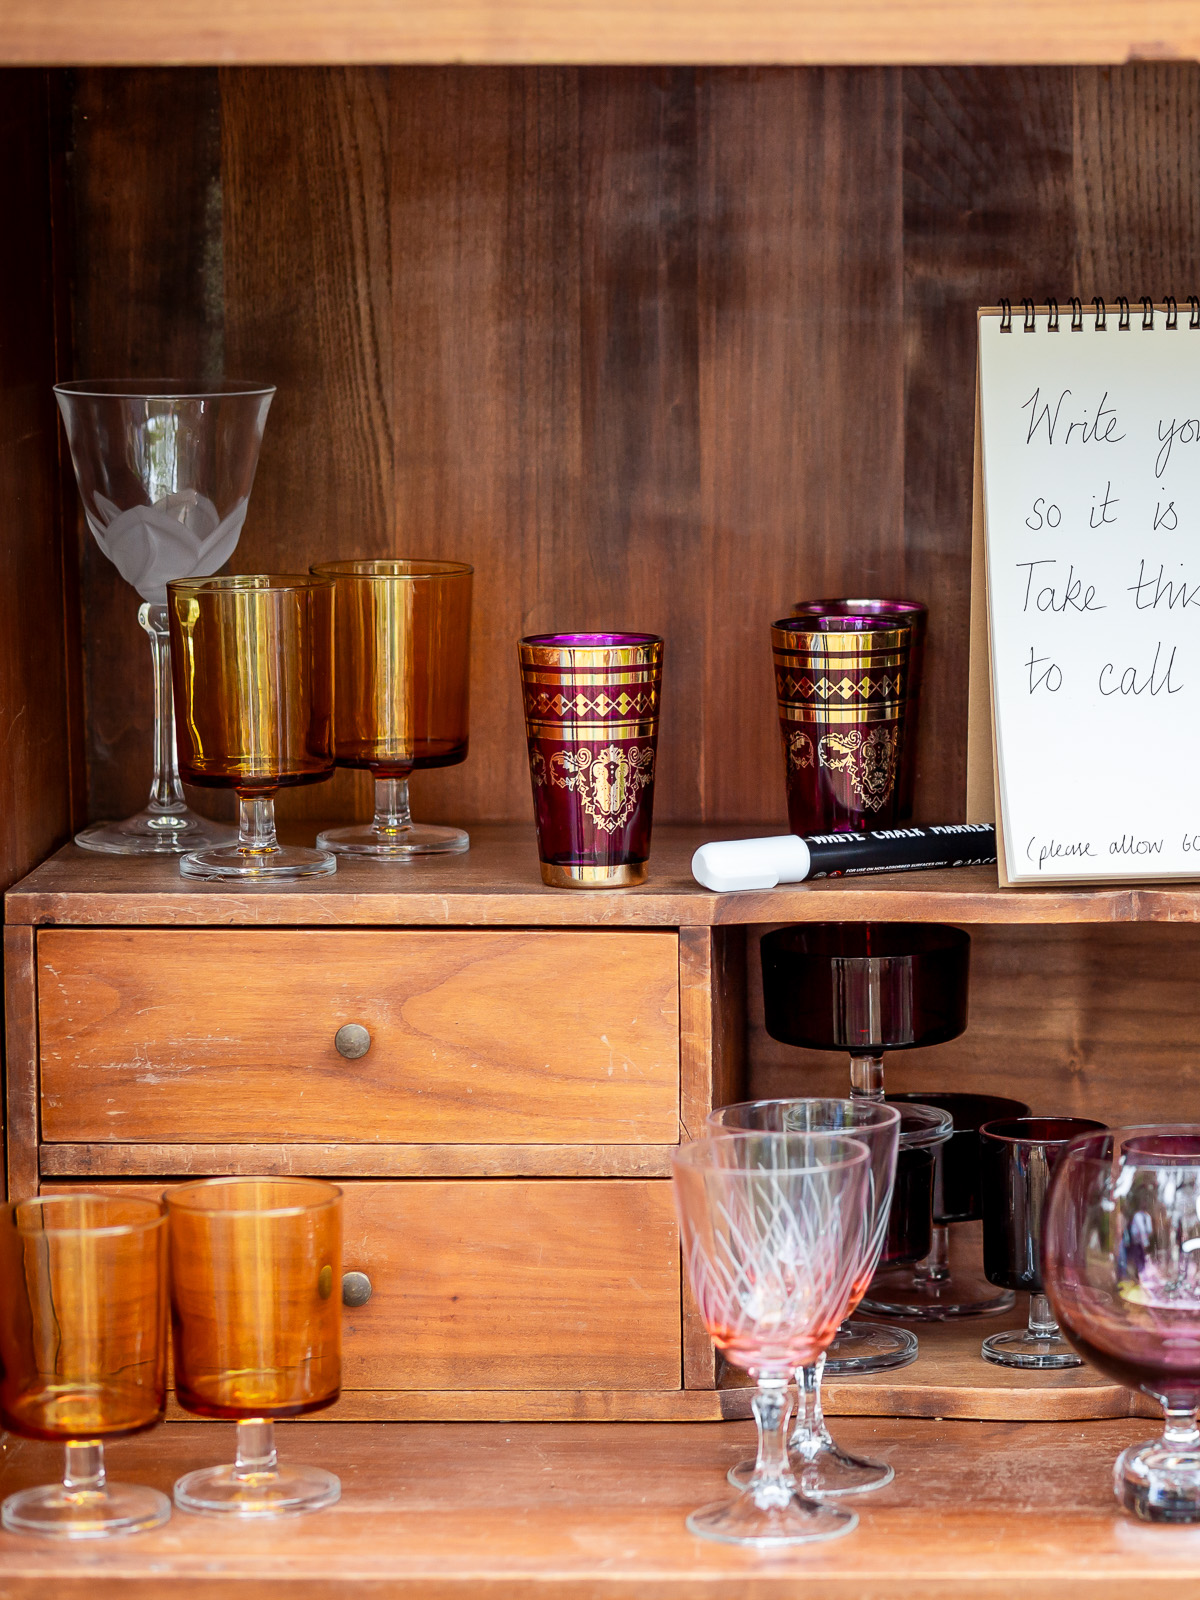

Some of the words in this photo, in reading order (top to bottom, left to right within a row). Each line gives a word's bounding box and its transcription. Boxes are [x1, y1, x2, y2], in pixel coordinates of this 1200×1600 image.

[1021, 387, 1126, 445] Write
[1025, 497, 1062, 531] so
[1089, 481, 1120, 529] it
[1153, 487, 1178, 531] is
[1016, 560, 1107, 612] Take
[1025, 646, 1062, 694] to
[1099, 642, 1184, 696] call
[811, 833, 866, 845] WHITE
[870, 827, 926, 840] CHALK
[929, 823, 994, 835] MARKER
[1026, 836, 1098, 871] (please
[1109, 834, 1165, 855] allow
